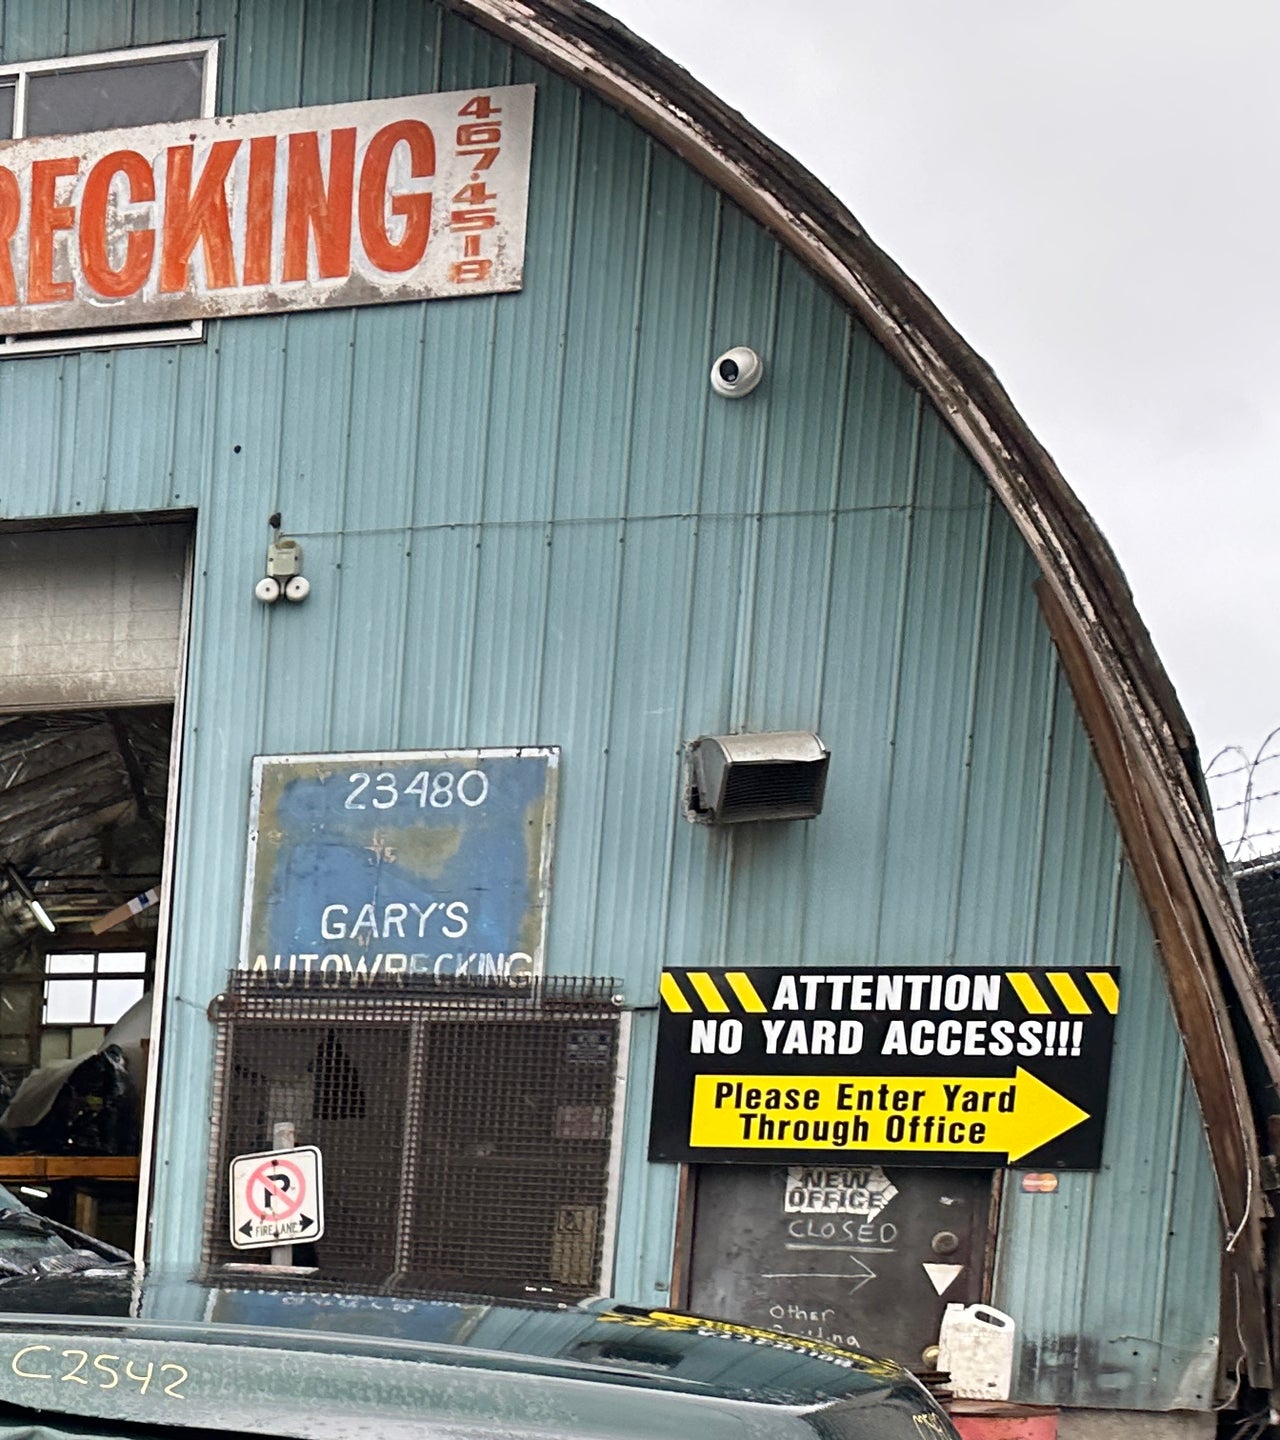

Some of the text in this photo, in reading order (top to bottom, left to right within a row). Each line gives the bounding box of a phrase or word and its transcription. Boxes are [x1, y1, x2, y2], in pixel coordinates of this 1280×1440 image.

[344, 769, 489, 809] 23480
[320, 901, 470, 940] GARY'S
[772, 974, 1001, 1012] ATTENTION
[689, 1019, 1084, 1057] NO YARD ACCESS!!!
[714, 1081, 1017, 1114] Please Enter Yard
[739, 1112, 987, 1148] Through Office
[802, 1170, 868, 1189] NEW
[788, 1187, 884, 1210] OFFICE
[255, 1225, 273, 1237] FIRE
[788, 1220, 898, 1244] CLOSED
[769, 1305, 836, 1321] Other
[11, 1345, 190, 1400] C2542
